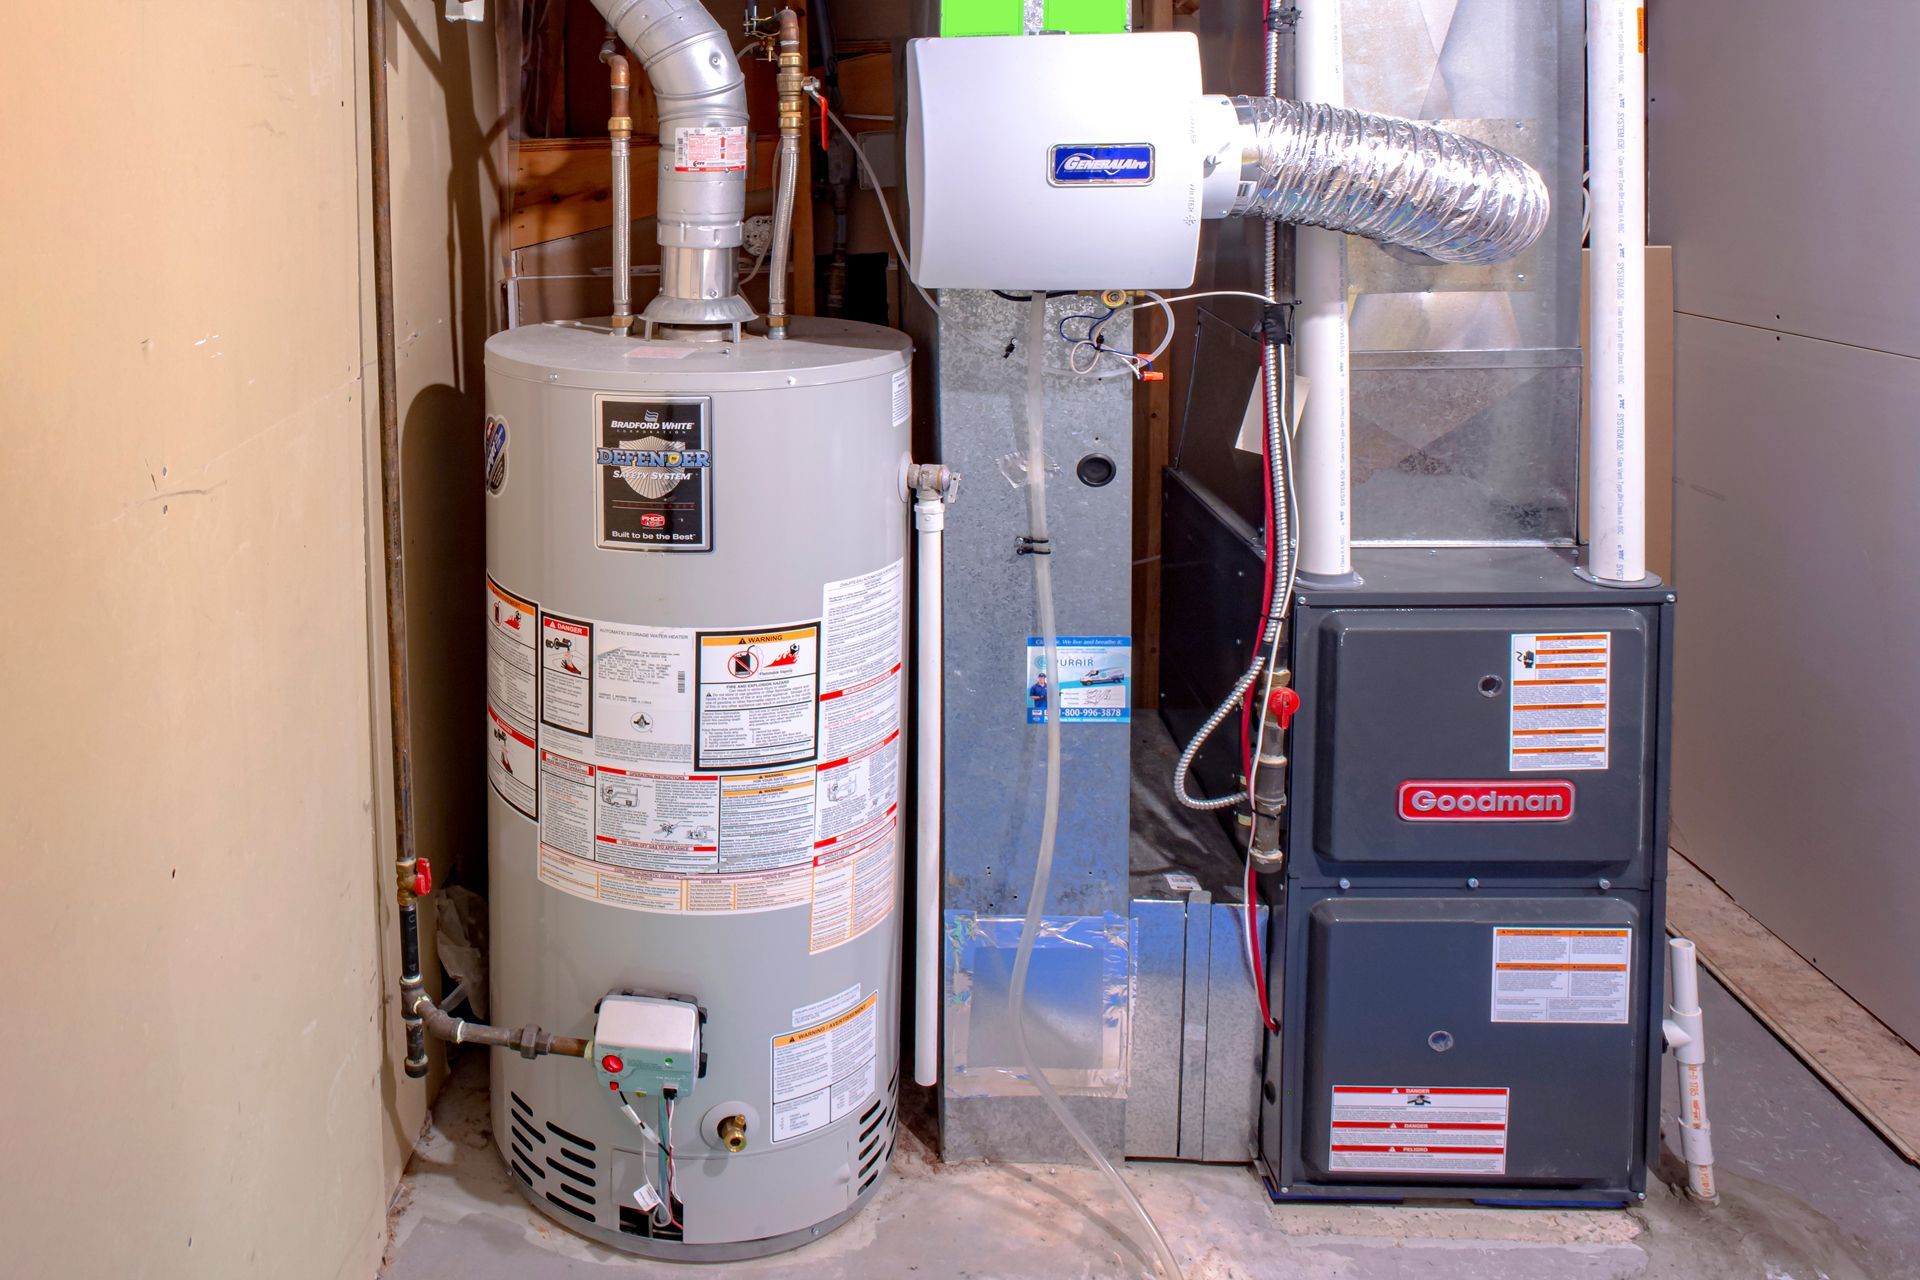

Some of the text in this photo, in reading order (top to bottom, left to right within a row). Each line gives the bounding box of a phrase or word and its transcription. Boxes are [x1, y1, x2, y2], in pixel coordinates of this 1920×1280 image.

[611, 420, 660, 430] BRADFORD
[598, 448, 711, 468] DEFENDER
[613, 470, 691, 480] SAFETY SYSTEM
[558, 624, 582, 634] DANGER
[748, 635, 783, 643] WARNING
[1412, 790, 1562, 811] Goodman
[799, 1027, 825, 1039] WARNING
[830, 1004, 866, 1028] AVERTISSEMENT
